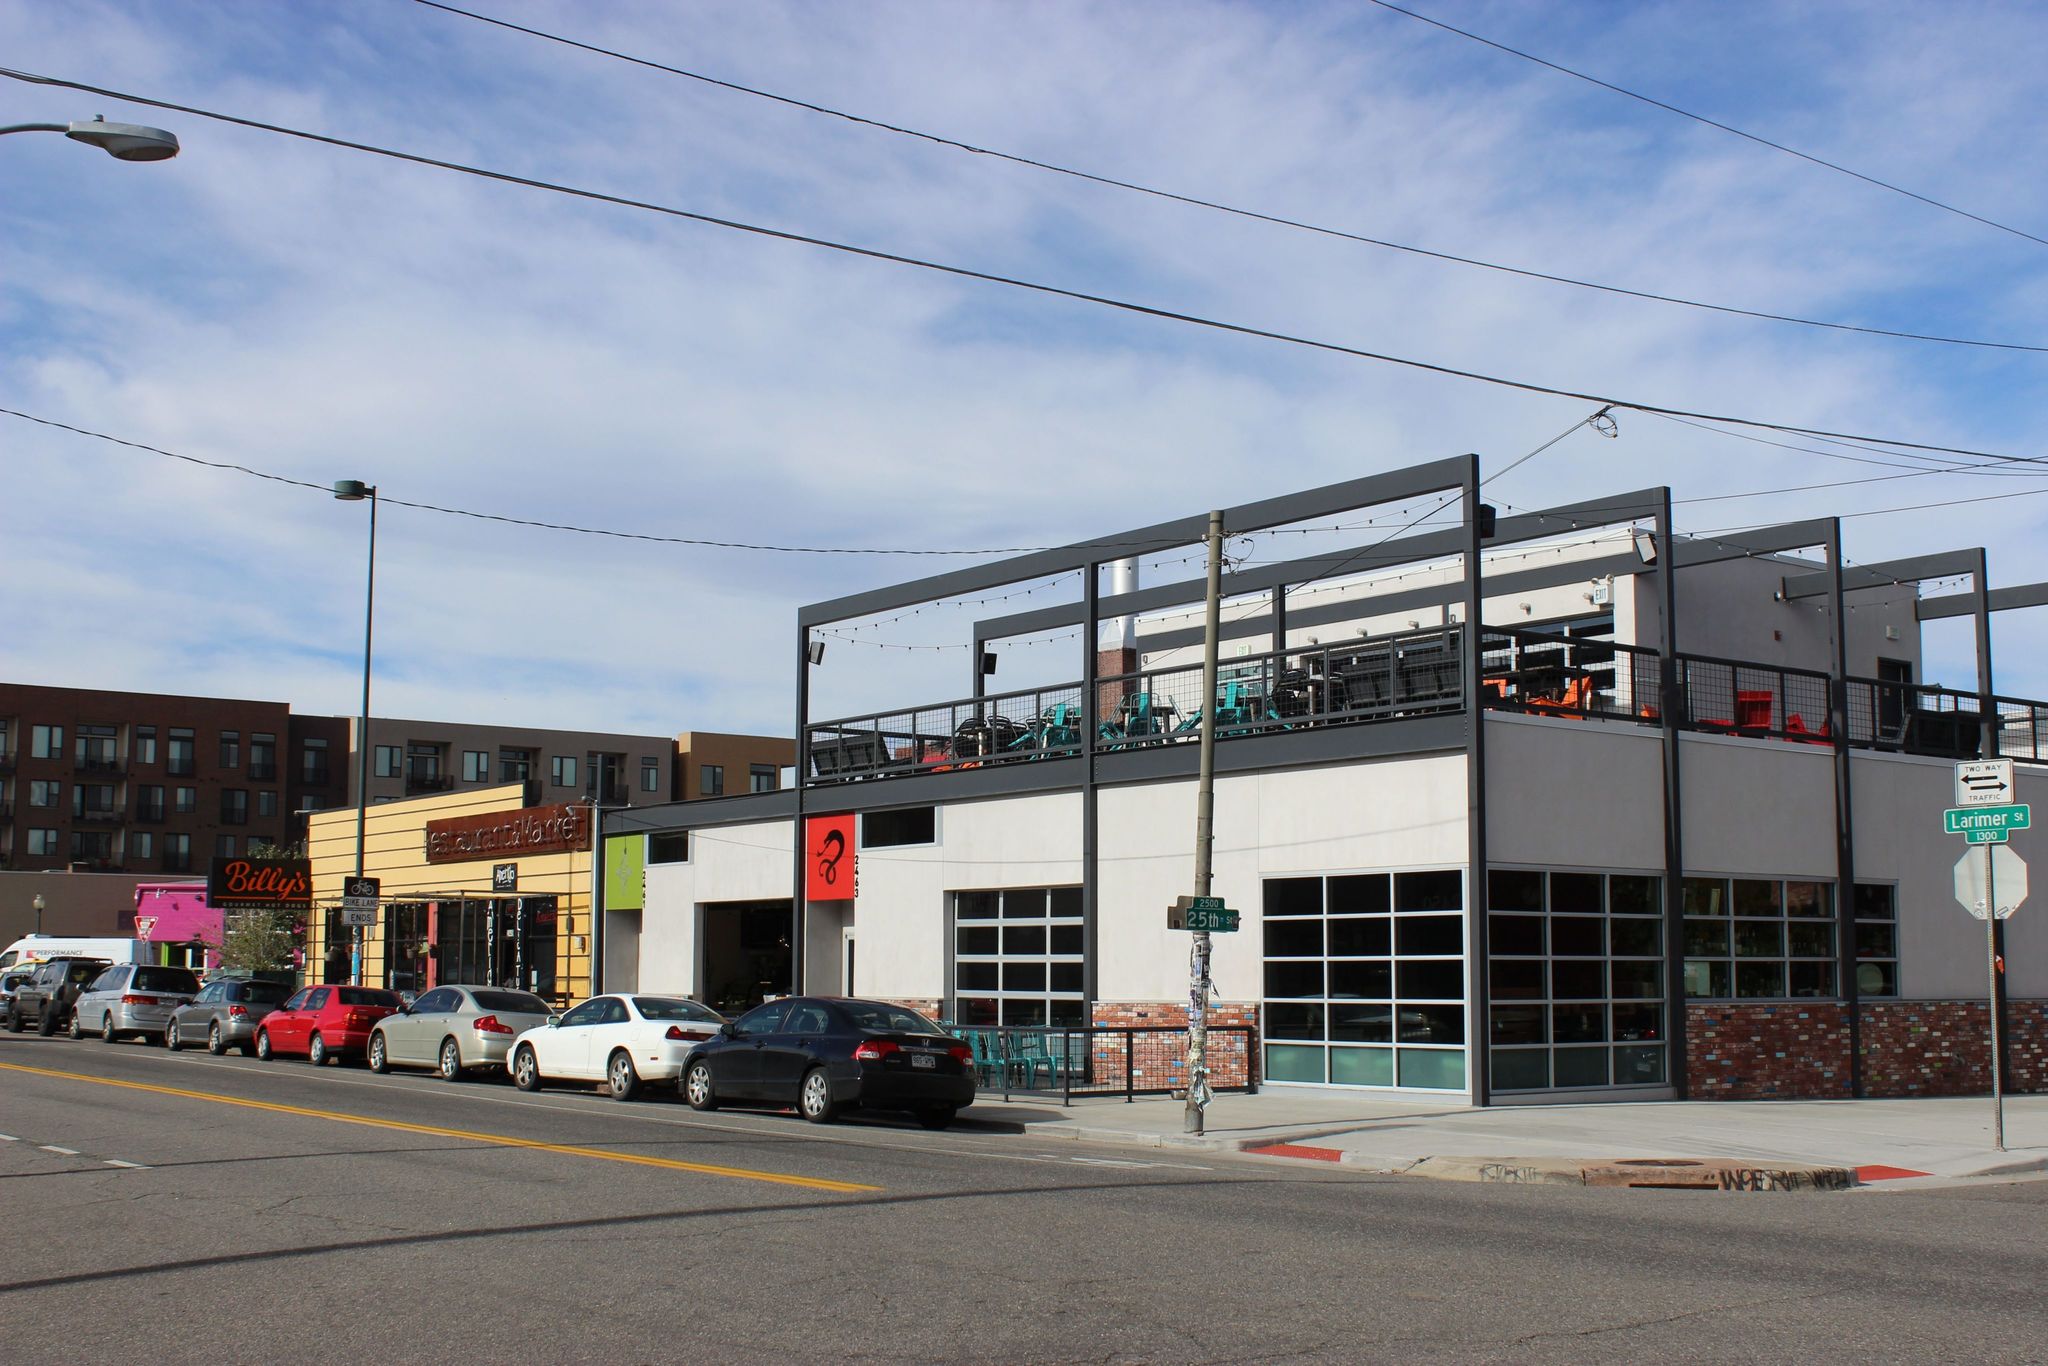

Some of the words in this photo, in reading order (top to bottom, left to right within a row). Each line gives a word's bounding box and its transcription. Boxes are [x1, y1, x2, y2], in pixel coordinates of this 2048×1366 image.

[1596, 588, 1606, 600] EXIT
[1952, 812, 2008, 829] Larimer
[2014, 812, 2024, 821] St
[1976, 832, 1998, 841] 1300
[225, 861, 306, 900] Billy's
[346, 898, 360, 906] BIKE
[1200, 899, 1219, 908] 2500
[1187, 911, 1219, 928] 25th
